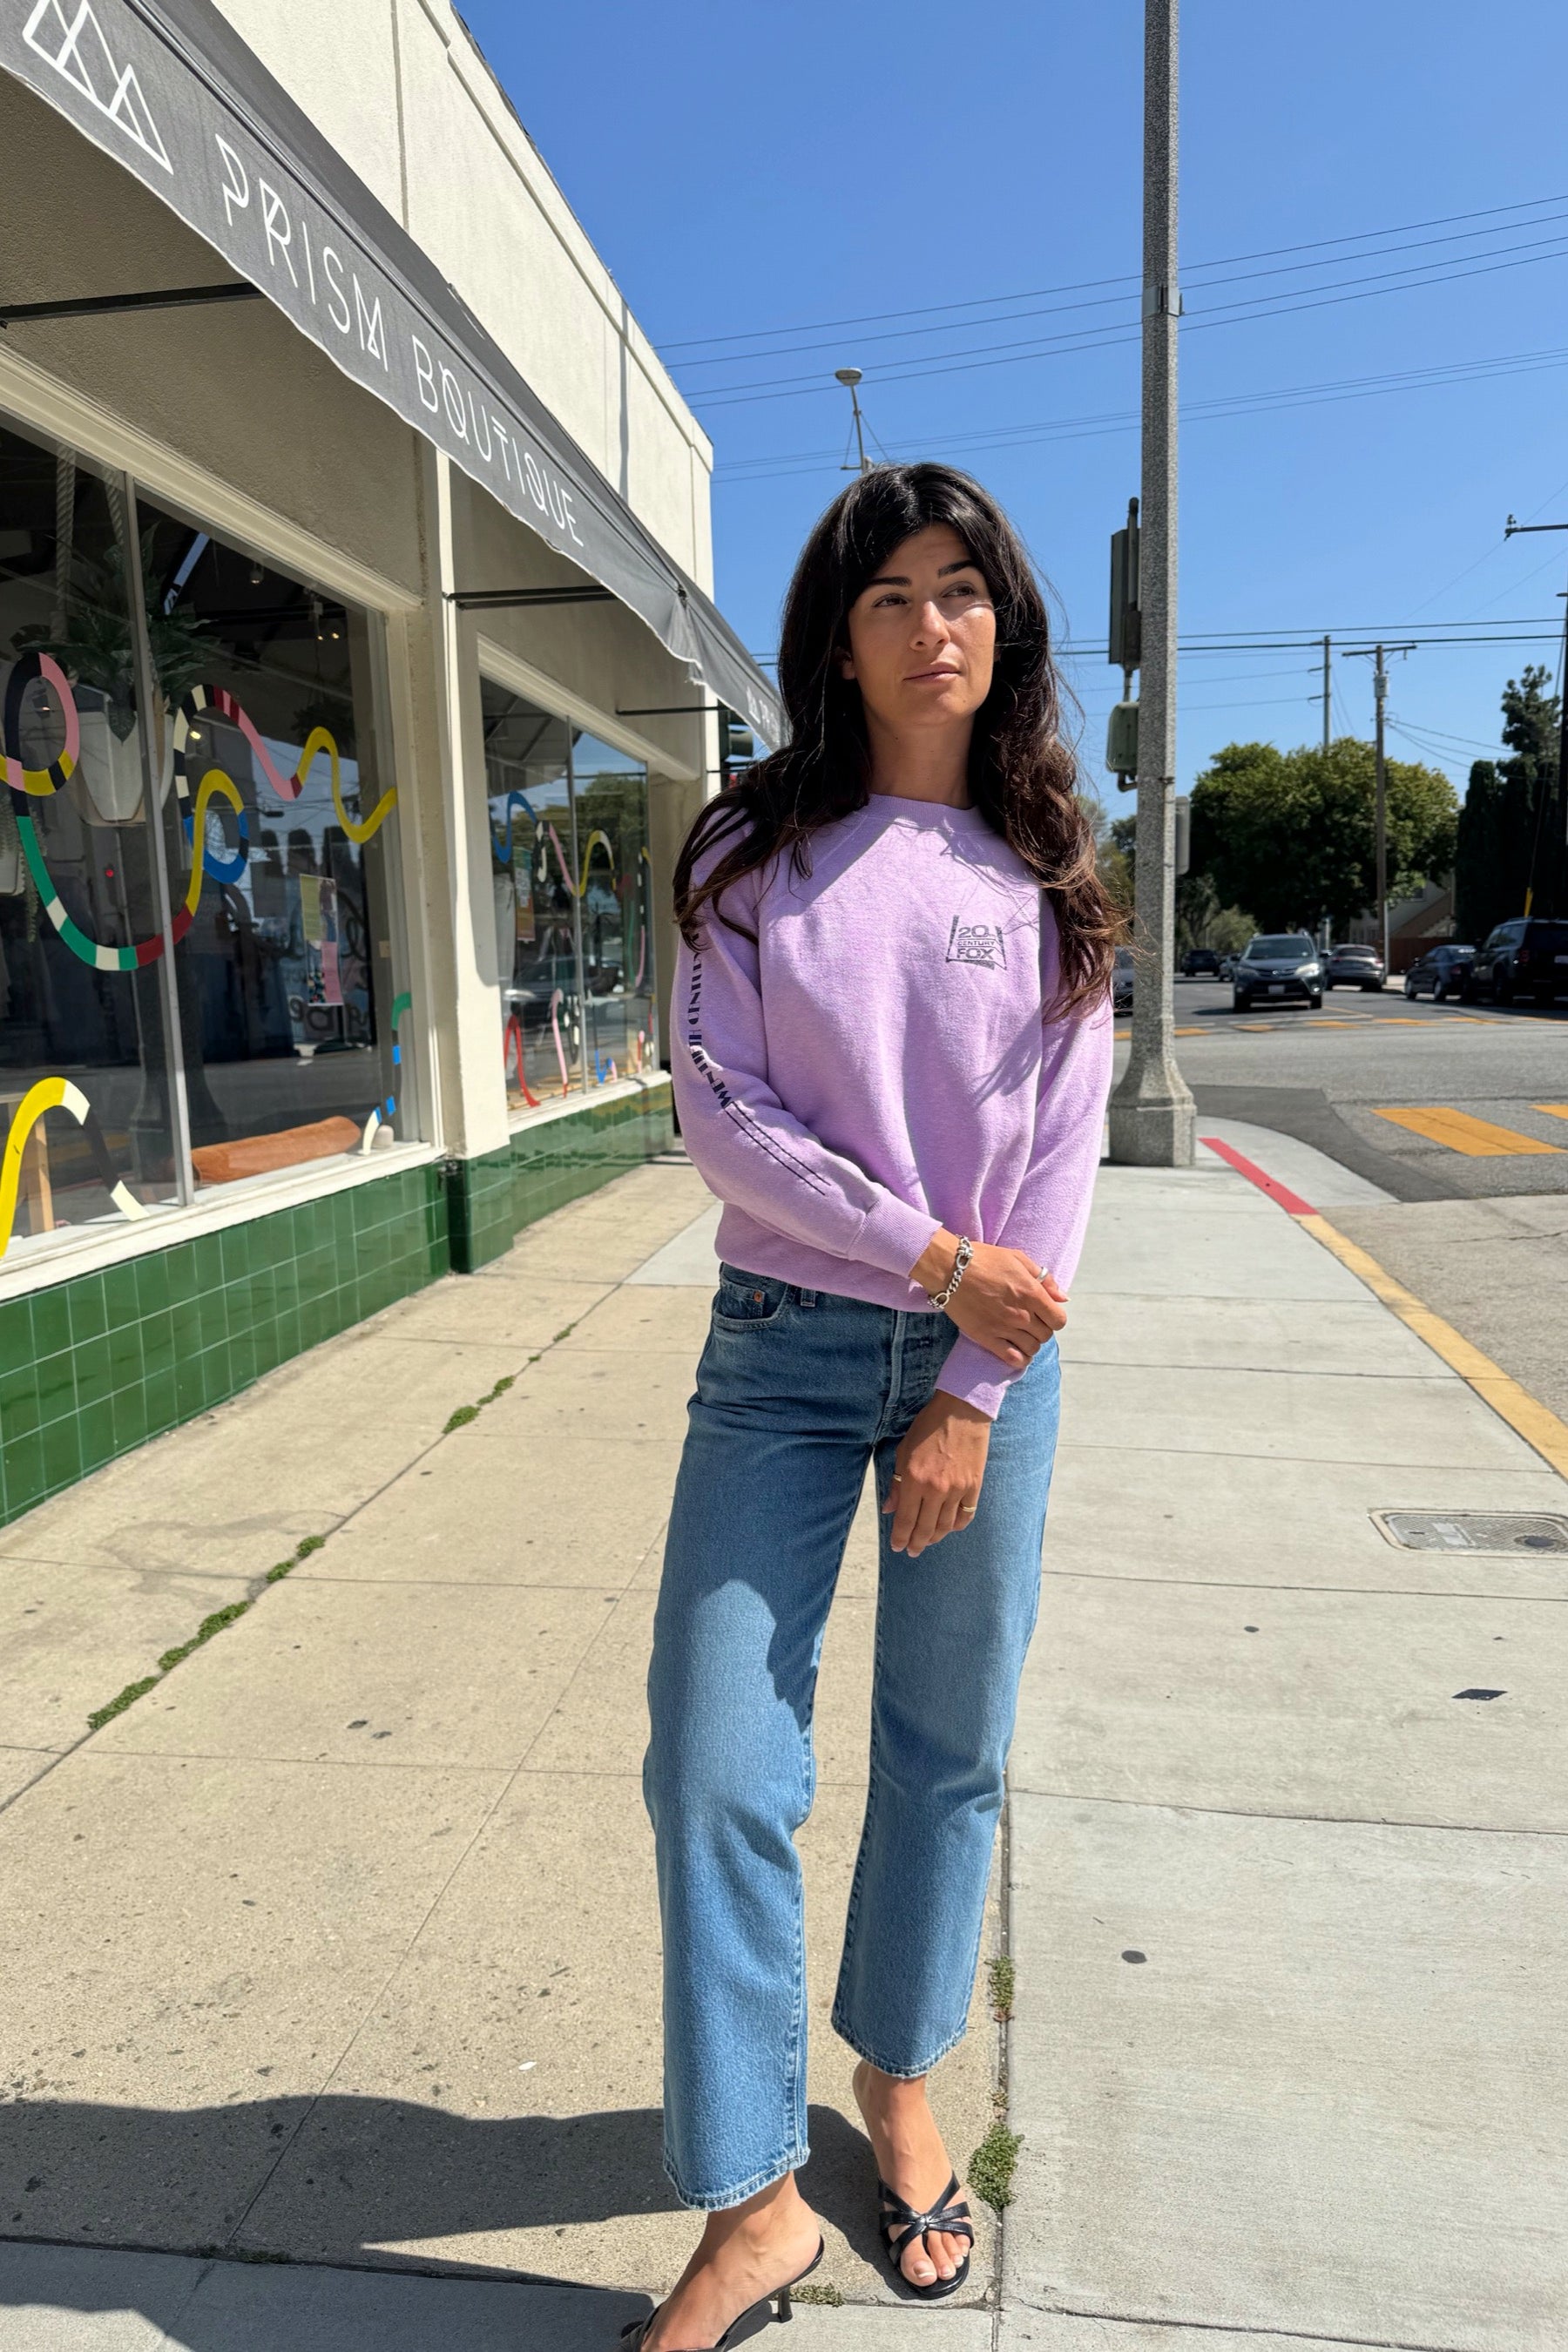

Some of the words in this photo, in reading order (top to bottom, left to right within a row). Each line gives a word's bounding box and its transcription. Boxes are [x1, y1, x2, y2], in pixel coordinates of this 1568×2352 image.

[215, 133, 389, 372] PRISM
[411, 335, 585, 548] BOUTIQUE
[956, 947, 994, 960] FOX
